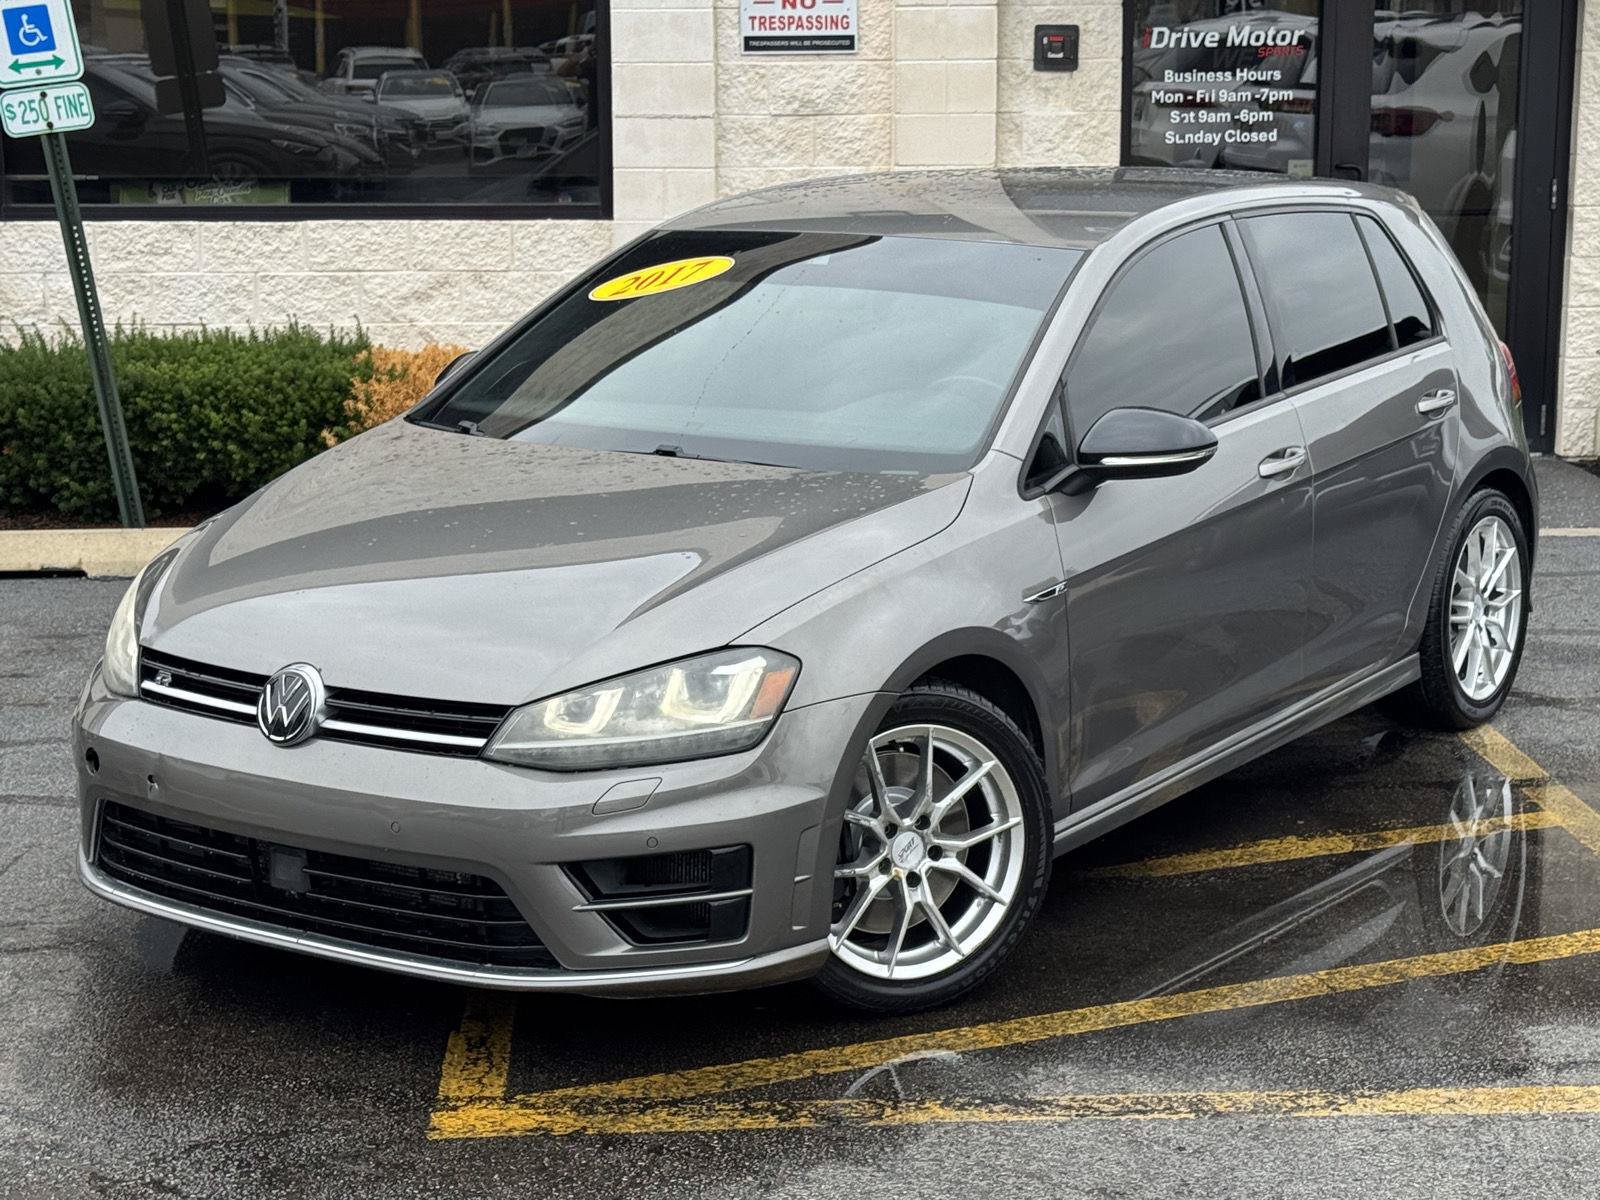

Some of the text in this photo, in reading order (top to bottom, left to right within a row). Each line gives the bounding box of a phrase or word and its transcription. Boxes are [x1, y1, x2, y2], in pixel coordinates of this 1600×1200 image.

[748, 15, 851, 31] TRESPASSING
[1142, 25, 1305, 49] iDrive Motor
[1257, 46, 1305, 58] SPORTS
[1164, 68, 1282, 83] Business Hours
[1151, 90, 1184, 104] Mon
[1219, 88, 1251, 102] 9am
[5, 93, 89, 125] $250 FINE
[1198, 110, 1231, 124] 9am
[1224, 129, 1278, 143] Closed
[607, 260, 715, 297] 2017
